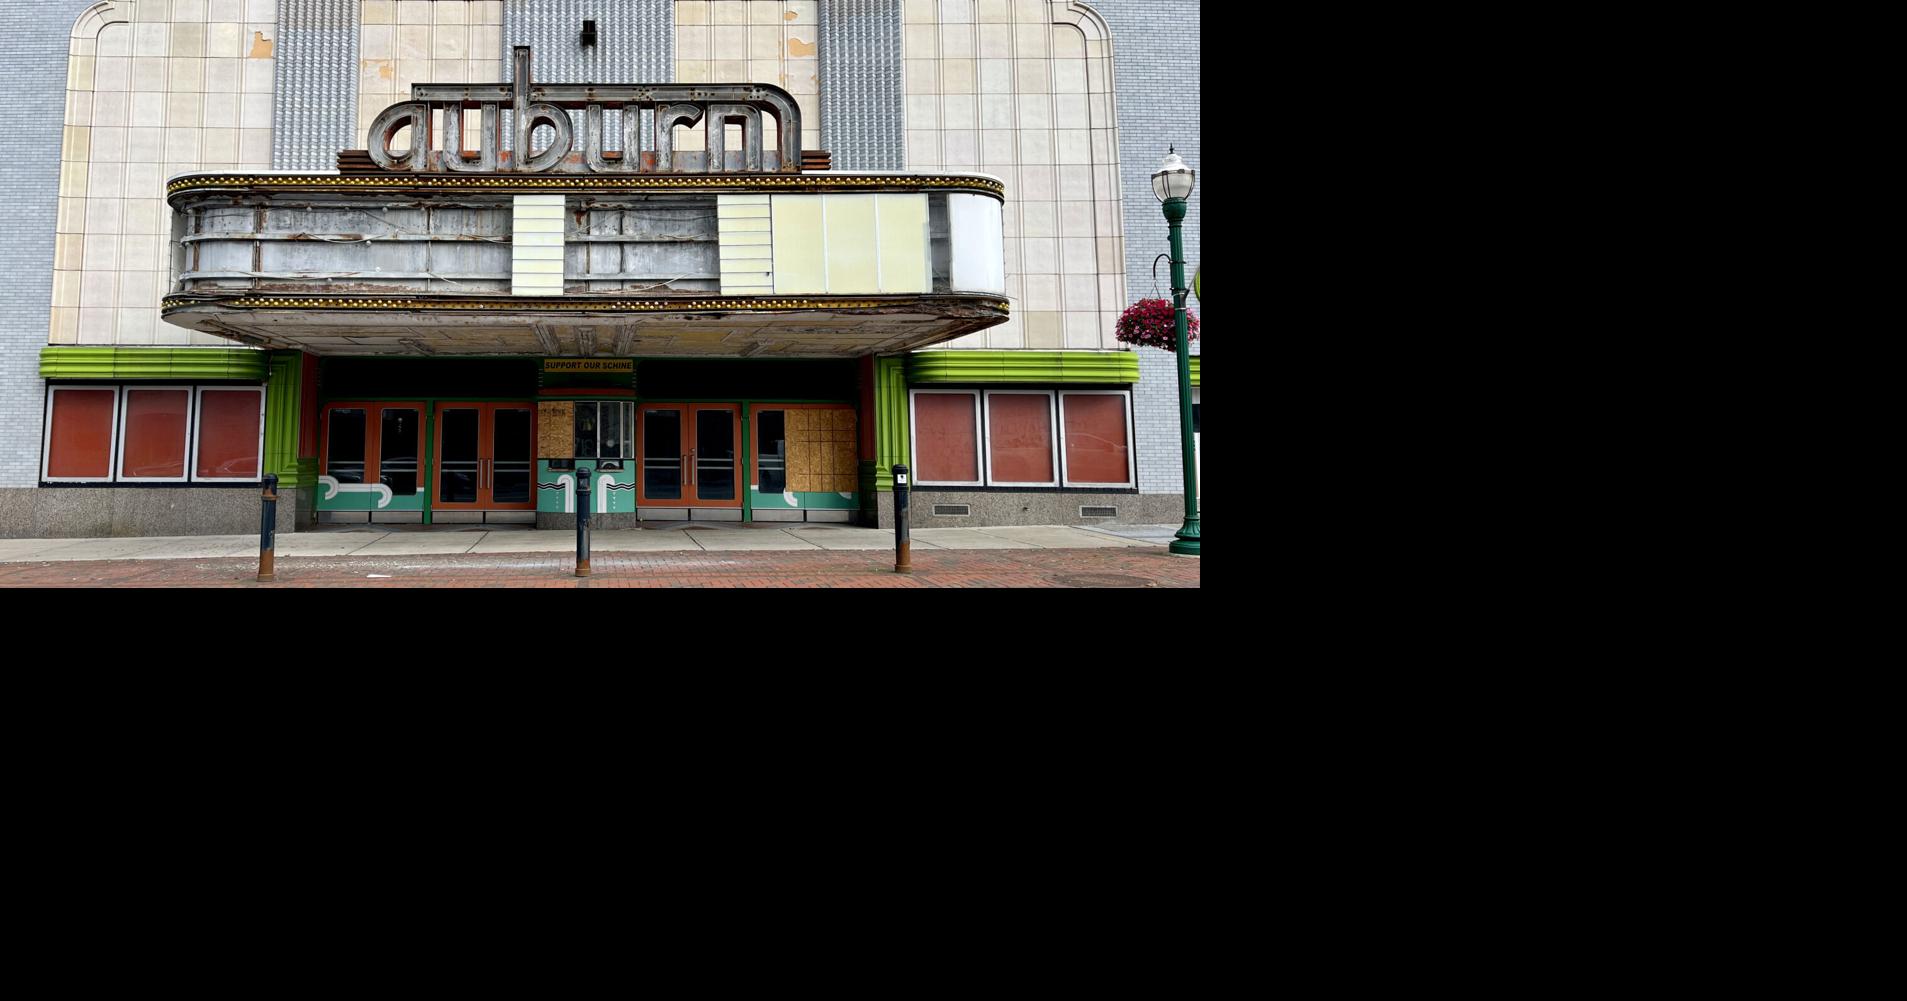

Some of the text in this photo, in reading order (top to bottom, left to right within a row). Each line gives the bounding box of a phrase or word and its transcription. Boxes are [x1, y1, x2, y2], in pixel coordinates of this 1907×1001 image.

[367, 46, 764, 173] auburn
[545, 361, 633, 369] SUPPORT OUR SCHINE
